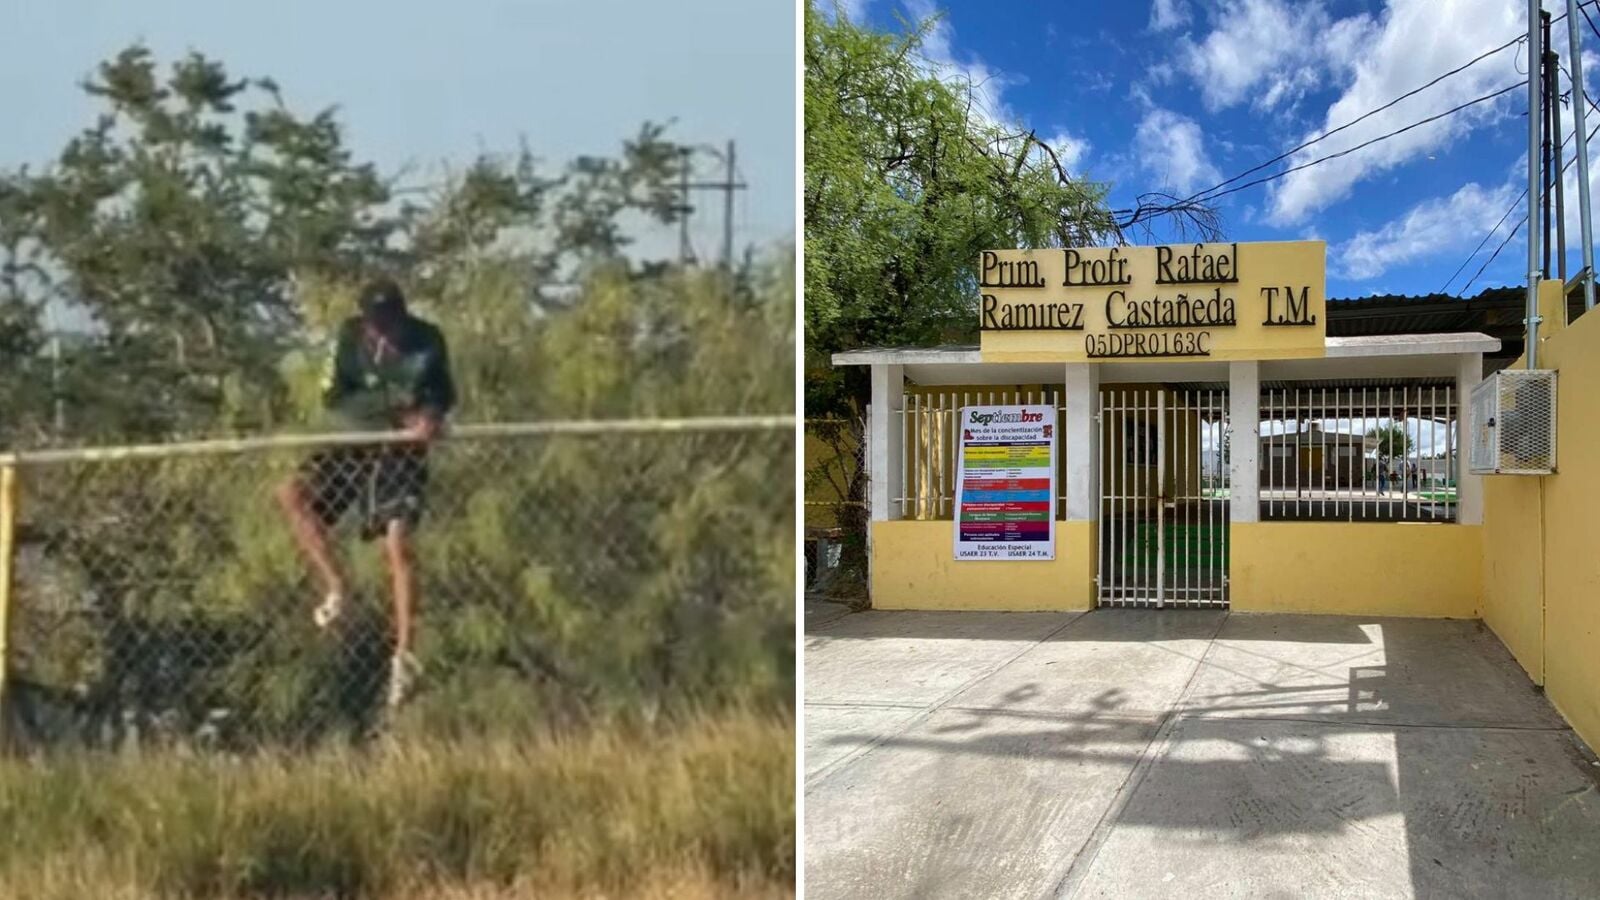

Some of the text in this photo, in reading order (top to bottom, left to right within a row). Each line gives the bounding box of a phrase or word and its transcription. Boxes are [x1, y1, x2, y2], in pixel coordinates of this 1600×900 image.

[980, 243, 1239, 288] Prim. Profr. Rafael
[980, 286, 1316, 330] Ramirez Castañeda T.M.
[1085, 331, 1211, 358] 05DPR0163C
[969, 409, 1043, 426] Septiembre
